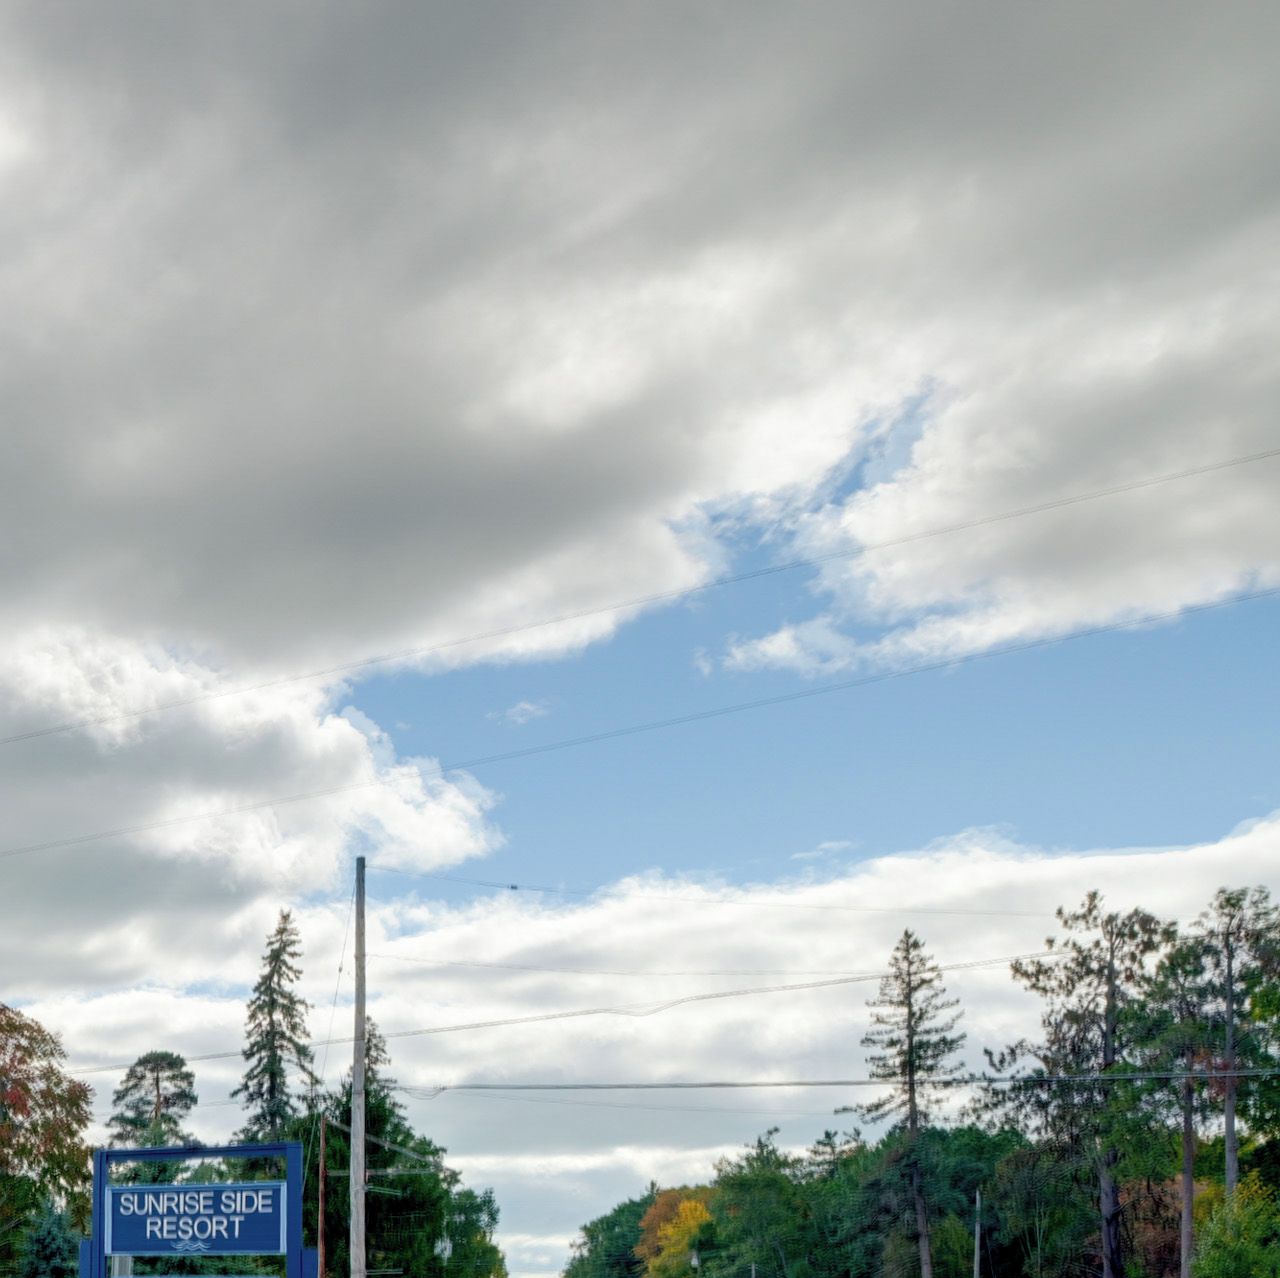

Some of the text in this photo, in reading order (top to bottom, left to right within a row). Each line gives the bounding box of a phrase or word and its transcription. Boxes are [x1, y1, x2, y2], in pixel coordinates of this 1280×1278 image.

[120, 1190, 273, 1215] SUNRISE SIDE
[146, 1215, 245, 1239] RESORT
